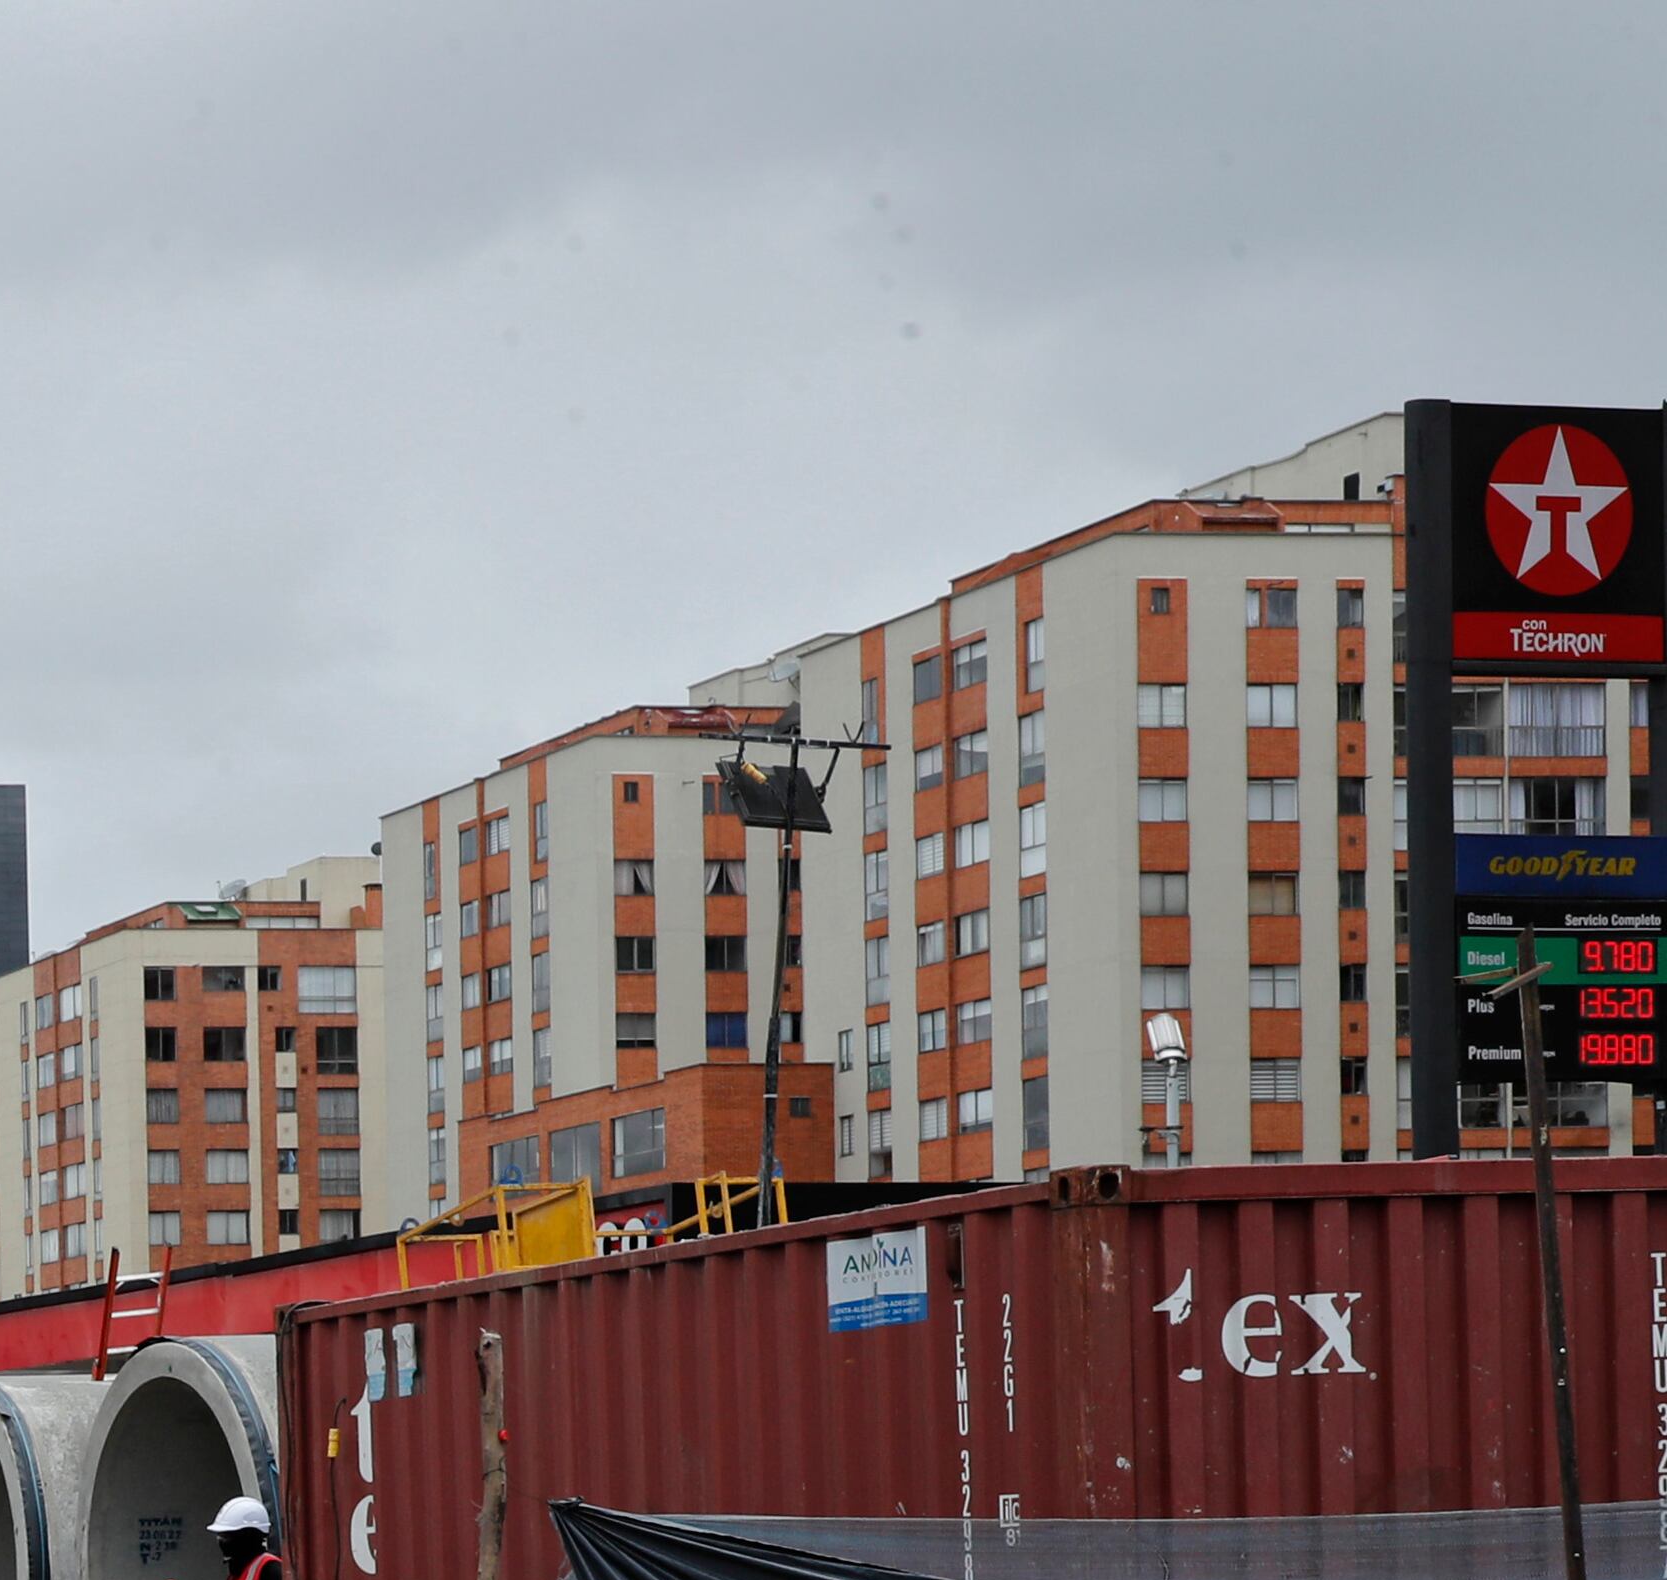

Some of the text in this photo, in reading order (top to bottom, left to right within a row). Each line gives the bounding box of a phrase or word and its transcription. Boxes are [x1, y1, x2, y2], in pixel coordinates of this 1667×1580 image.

[1522, 620, 1547, 630] con
[1510, 628, 1605, 657] TECHRON
[1489, 851, 1637, 881] GOODYEAR
[1467, 912, 1662, 928] Gasolina Servicio Completo
[1467, 951, 1505, 966] Diesel
[1467, 999, 1495, 1014] Plus
[1468, 1046, 1522, 1060] Premium
[953, 1299, 969, 1436] TEMU
[1002, 1293, 1015, 1433] 22G1
